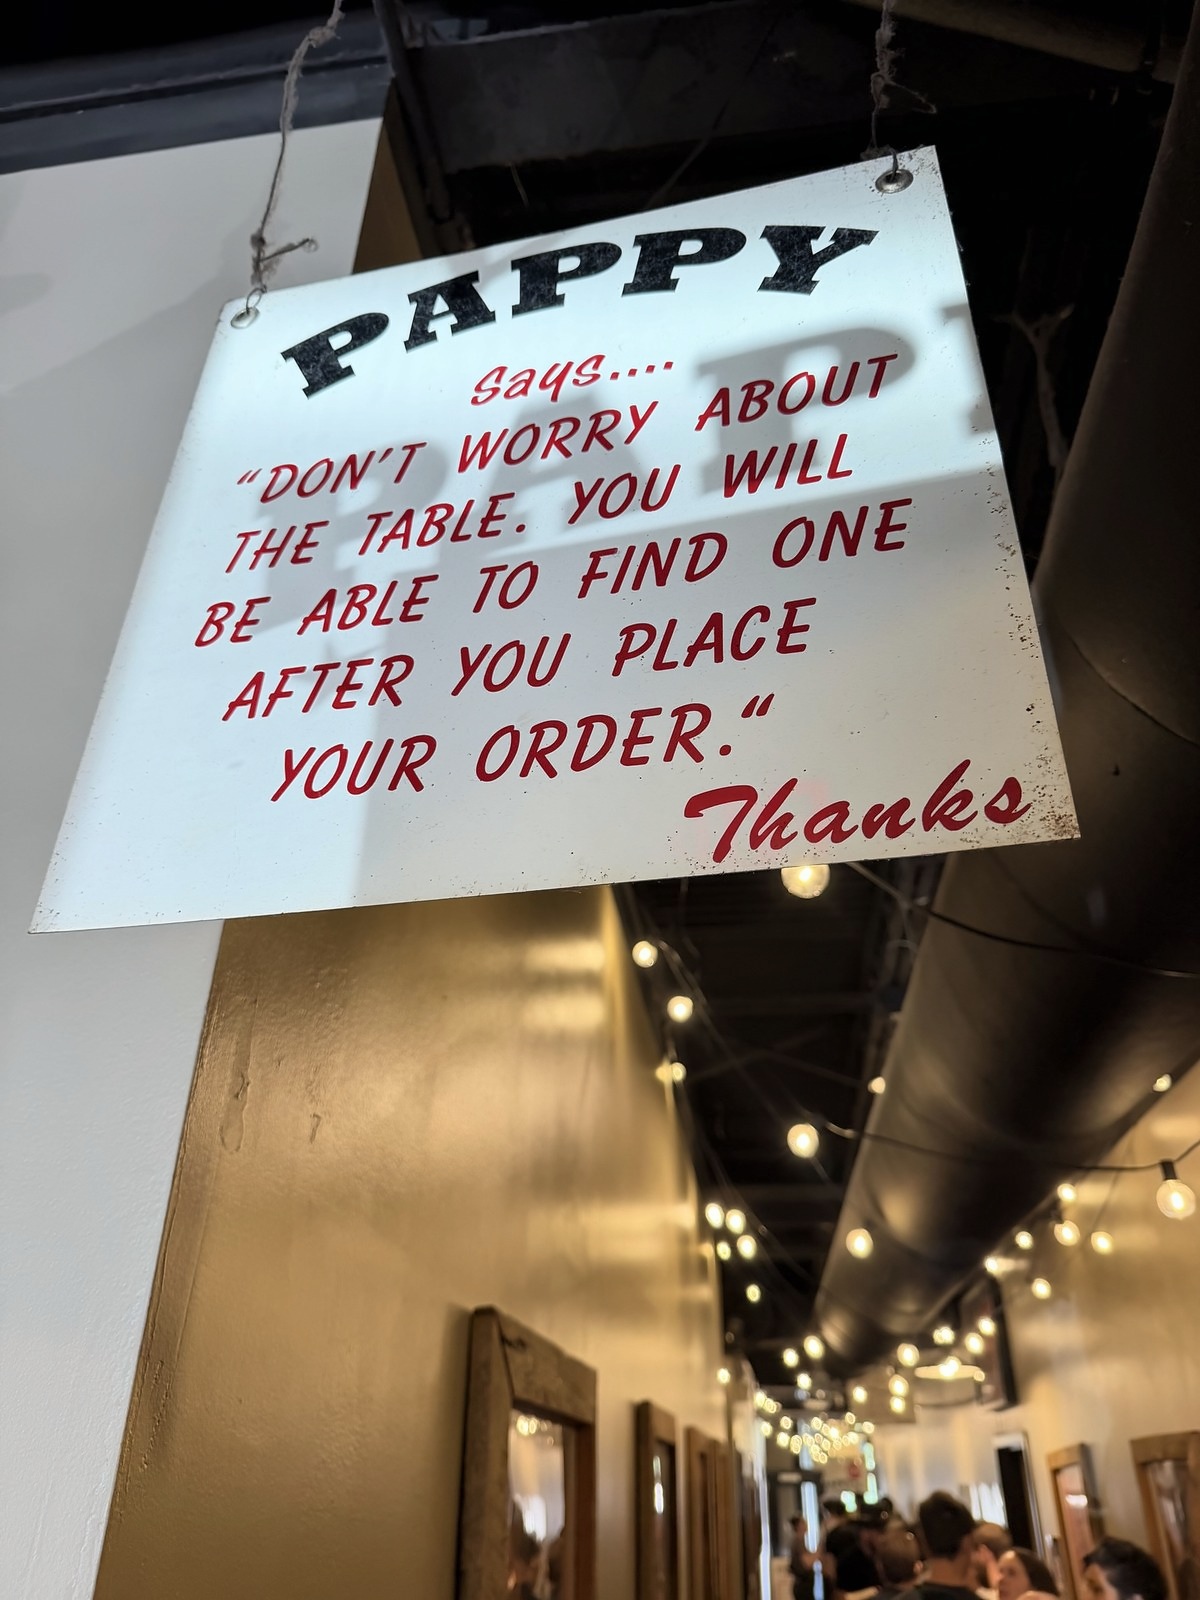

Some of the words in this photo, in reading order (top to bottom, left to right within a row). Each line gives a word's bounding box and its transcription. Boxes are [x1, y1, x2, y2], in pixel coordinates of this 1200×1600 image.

[280, 225, 878, 398] PAPPY
[457, 400, 659, 474] WORRY
[695, 353, 898, 432] ABOUT
[470, 354, 674, 406] Says....
[225, 520, 330, 574] THE
[358, 492, 527, 556] TABLE.
[568, 464, 681, 525] YOU
[723, 433, 853, 499] WILL
[194, 596, 271, 648] BE
[297, 574, 439, 636] ABLE
[473, 560, 540, 614] TO
[577, 531, 728, 599] FIND
[772, 498, 913, 569] ONE
[222, 655, 415, 722] AFTER
[451, 633, 571, 697] YOU
[611, 597, 817, 678] PLACE
[270, 734, 437, 803] YOUR
[683, 759, 1029, 864] Thanks
